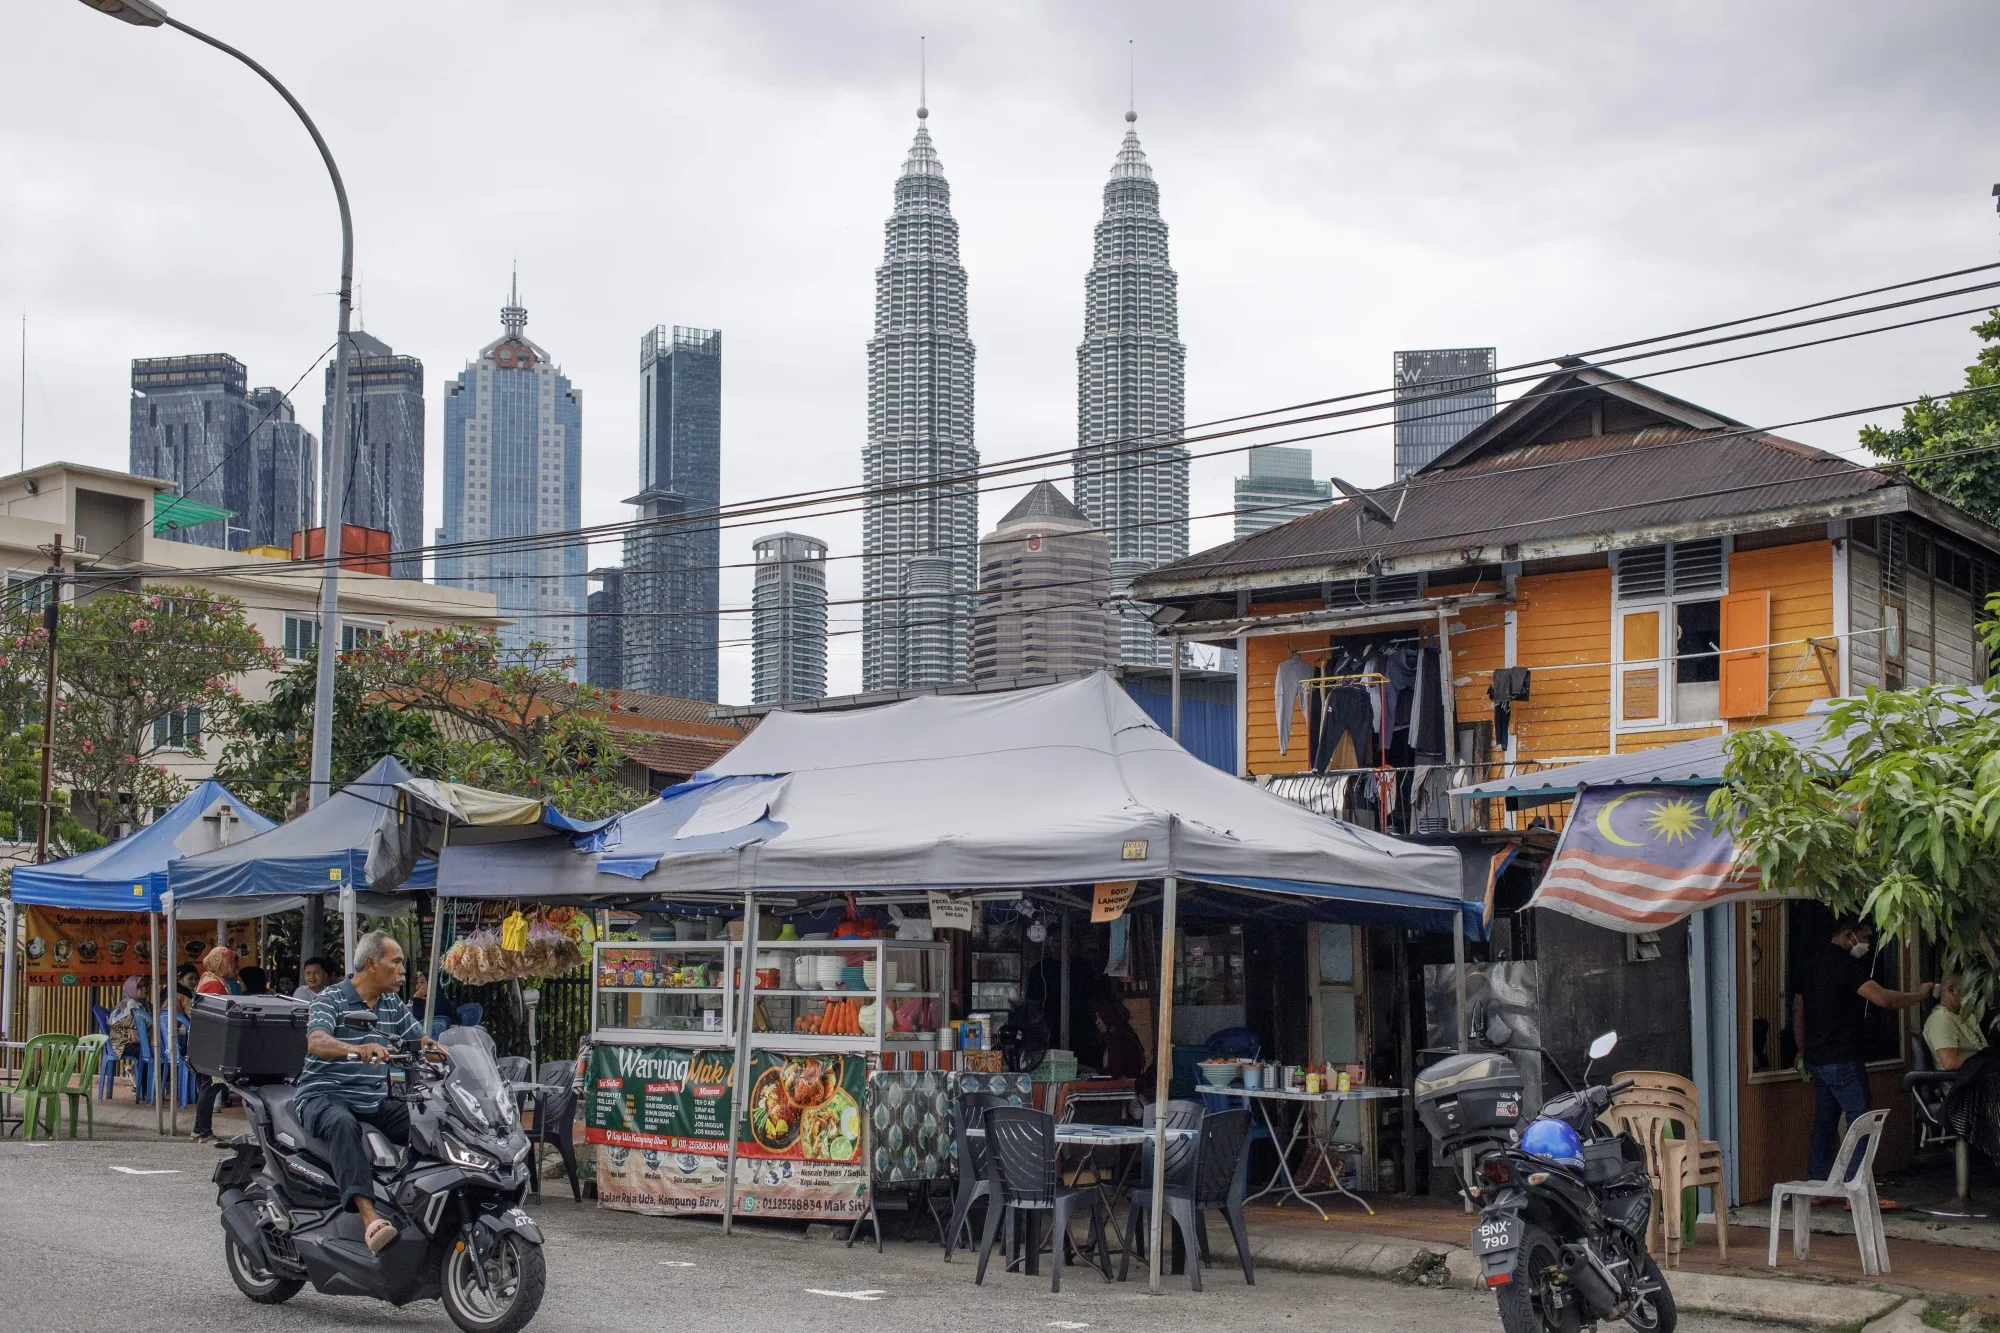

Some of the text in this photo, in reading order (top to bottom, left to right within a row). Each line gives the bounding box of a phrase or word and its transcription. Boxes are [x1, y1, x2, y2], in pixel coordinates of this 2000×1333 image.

[1402, 369, 1422, 383] W
[55, 914, 81, 926] Sedia
[619, 1047, 689, 1093] Warung
[685, 1057, 726, 1084] Mak
[600, 1191, 621, 1203] Jalan
[622, 1192, 637, 1205] Raja
[658, 1194, 697, 1209] Kampung
[762, 1198, 822, 1211] 01125588834
[824, 1200, 846, 1212] Mak
[1481, 1222, 1507, 1237] BNX
[1482, 1234, 1509, 1249] 790
